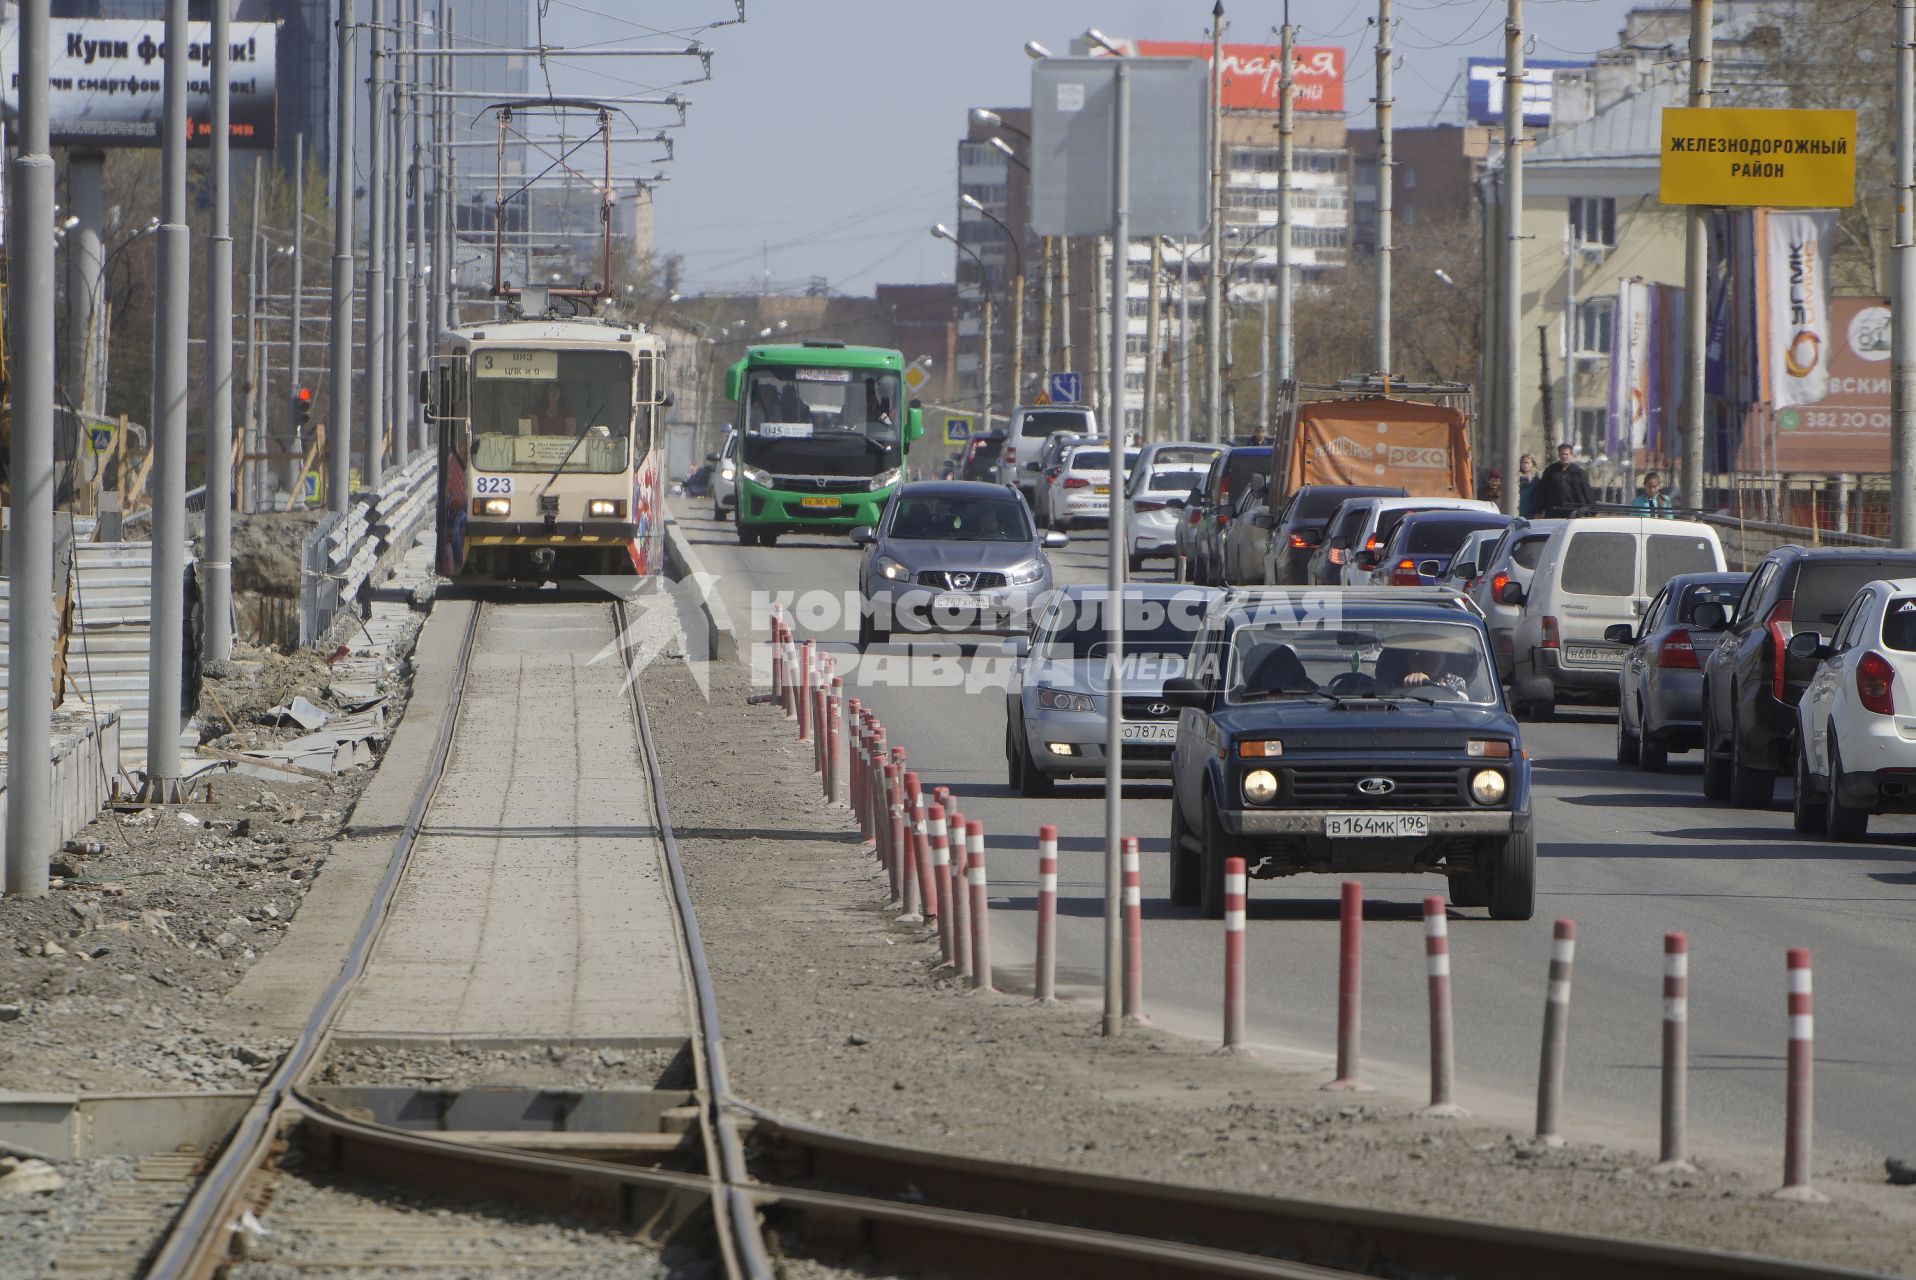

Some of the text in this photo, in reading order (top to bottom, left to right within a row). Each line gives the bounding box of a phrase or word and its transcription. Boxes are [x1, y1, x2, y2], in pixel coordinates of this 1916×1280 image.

[66, 32, 129, 64] Купи
[77, 75, 160, 96] смартфон
[1671, 137, 1847, 155] ЖЕЛЕЗНОДОРОЖНЫЙ
[1731, 161, 1784, 177] РАЙОН
[1789, 243, 1806, 325] УГМК
[484, 355, 494, 370] 3
[1841, 412, 1866, 428] 20
[528, 442, 536, 458] 3
[476, 477, 512, 494] 823
[1124, 725, 1175, 738] О787АС
[1332, 816, 1422, 833] В164МК 196
